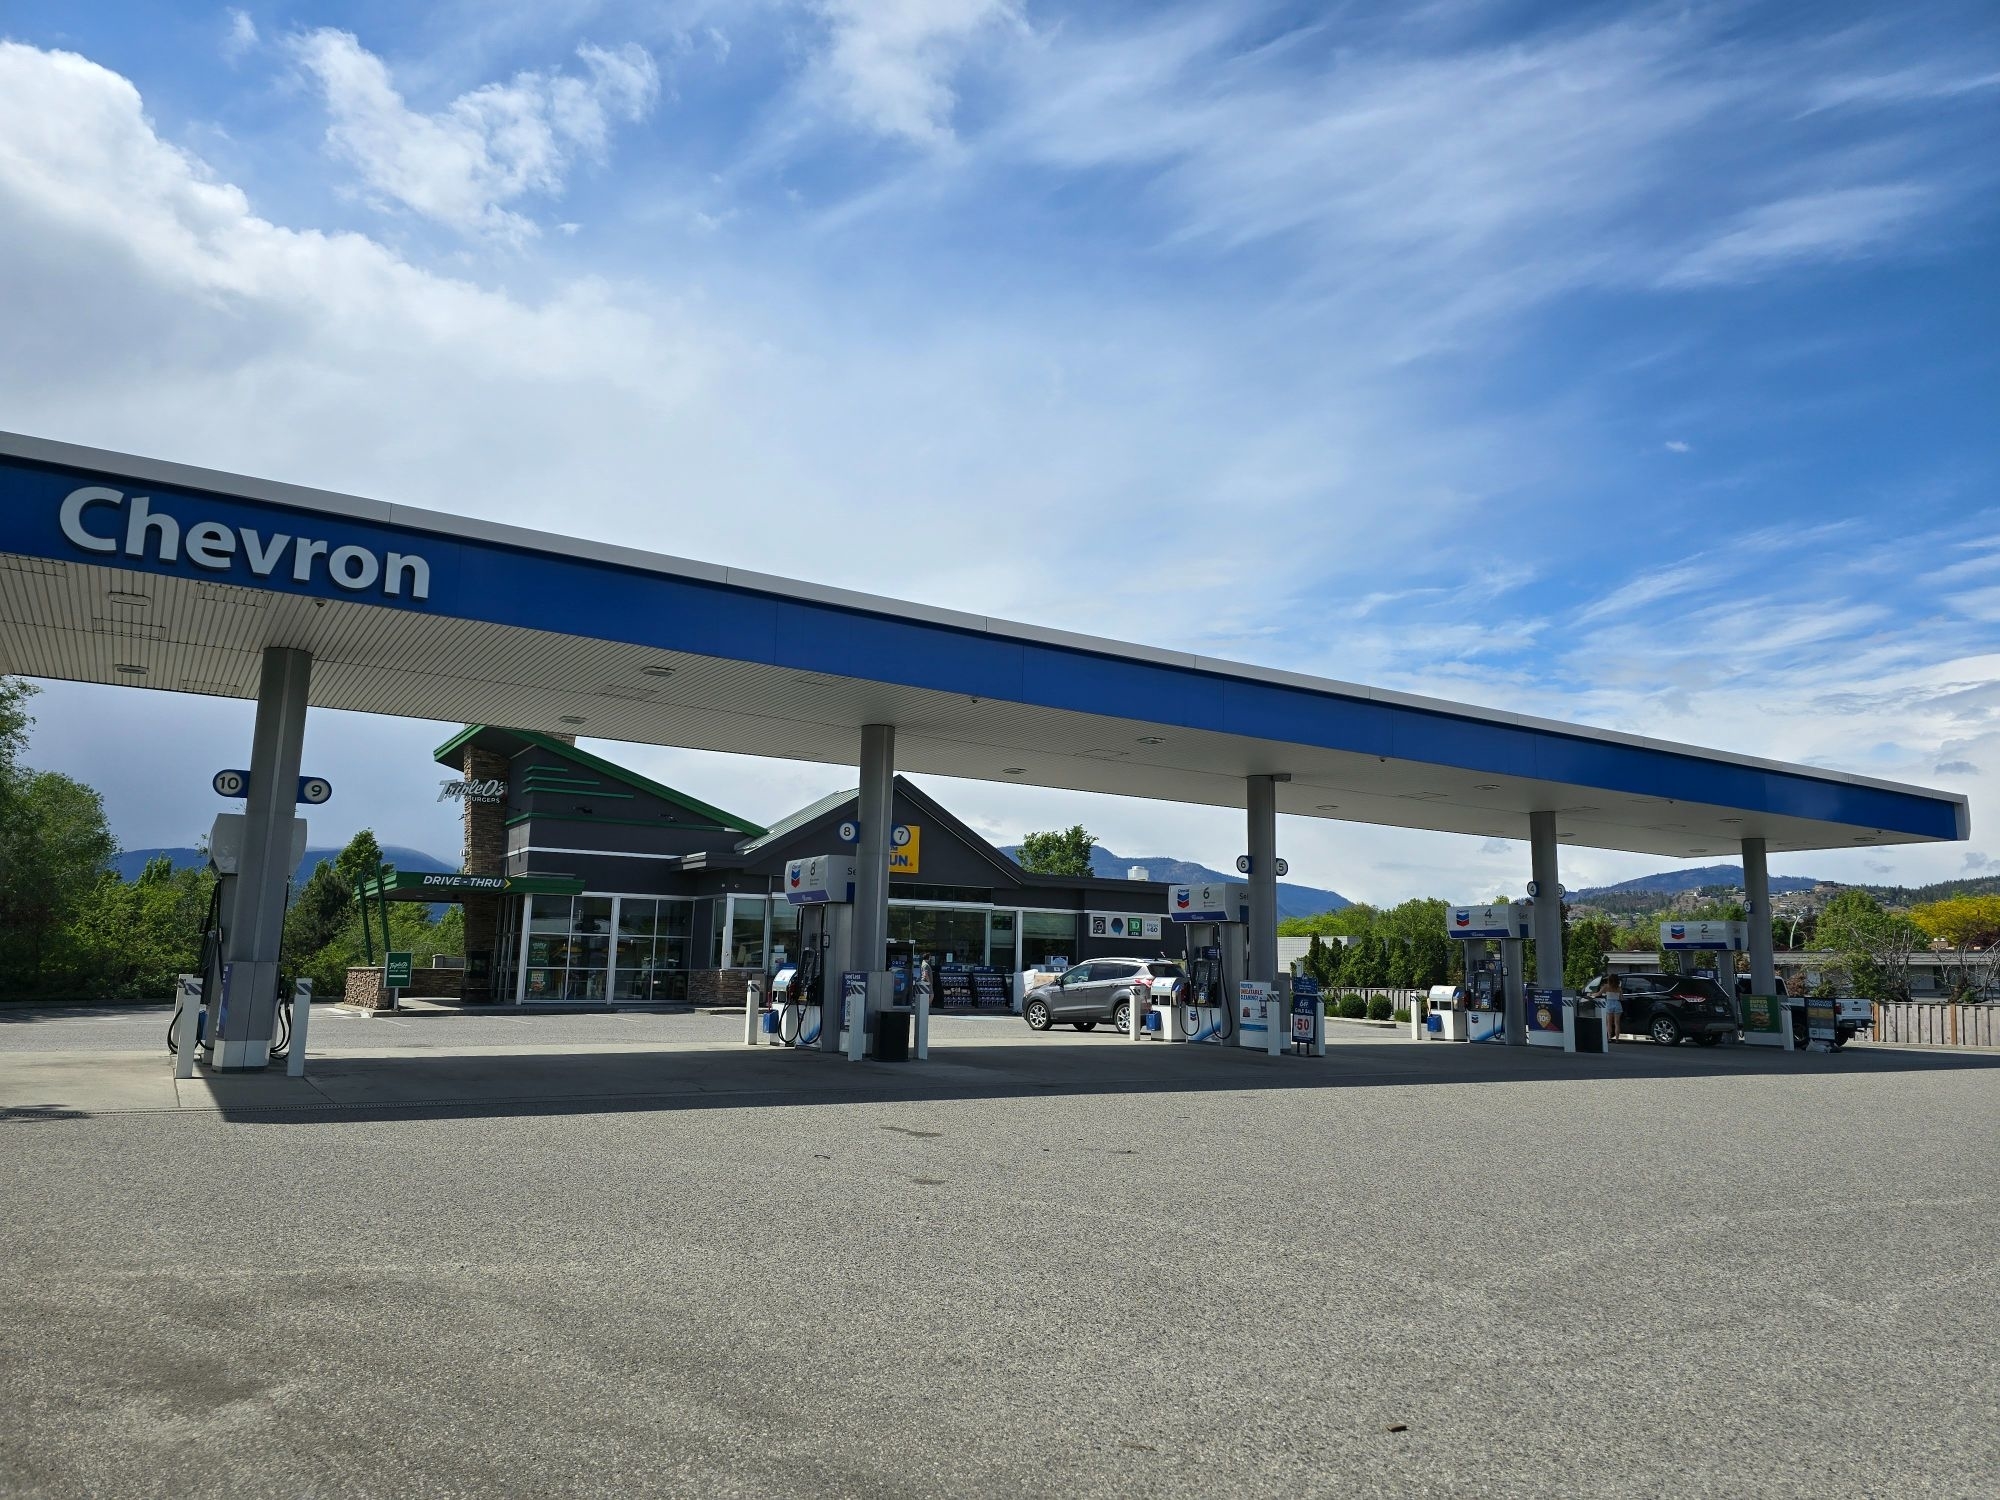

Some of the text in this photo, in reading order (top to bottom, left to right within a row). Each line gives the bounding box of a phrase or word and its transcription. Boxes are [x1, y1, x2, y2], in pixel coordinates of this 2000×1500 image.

[59, 486, 430, 599] Chevron
[219, 776, 239, 790] 10
[311, 784, 322, 797] 9
[843, 826, 851, 837] 8
[897, 830, 905, 841] 7
[889, 854, 908, 867] UN
[1240, 860, 1247, 869] 6
[810, 861, 816, 876] 8
[1278, 863, 1284, 872] 5
[423, 875, 461, 886] DRIVE
[470, 877, 502, 888] THRU
[1203, 887, 1210, 900] 6
[1484, 908, 1493, 919] 4
[1130, 920, 1140, 930] TD
[1701, 923, 1709, 934] 2
